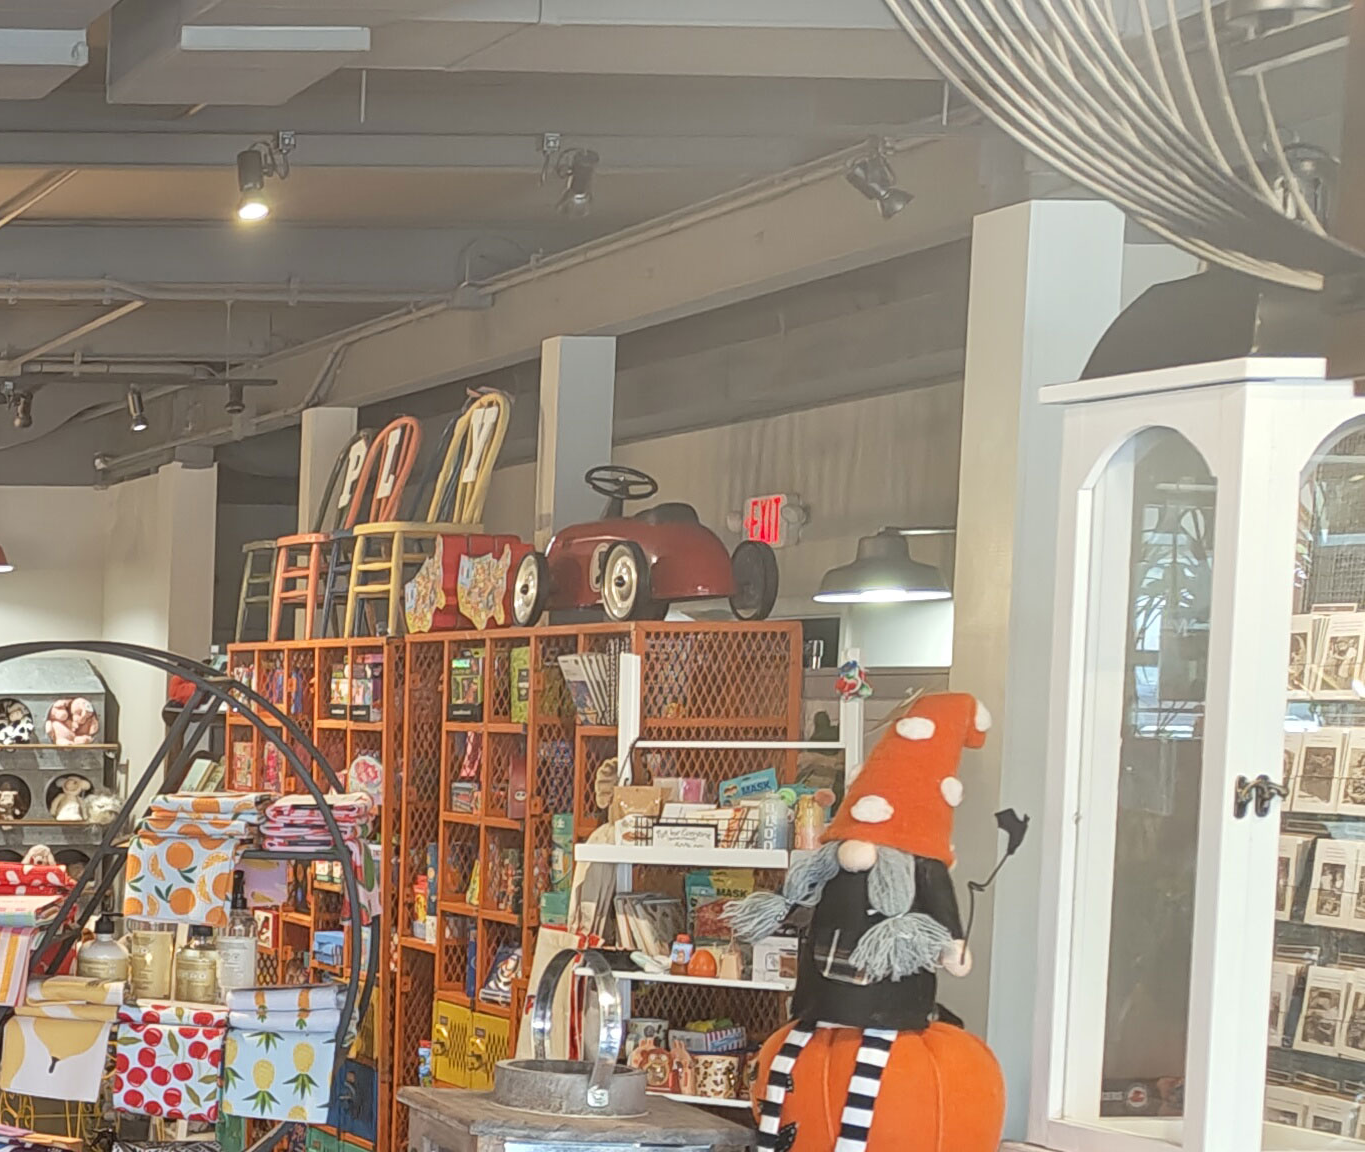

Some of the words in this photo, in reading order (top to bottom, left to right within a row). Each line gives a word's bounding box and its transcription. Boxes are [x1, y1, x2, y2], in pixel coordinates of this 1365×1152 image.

[749, 496, 782, 543] EXIT
[740, 779, 772, 796] MASK
[716, 888, 749, 898] MASK
